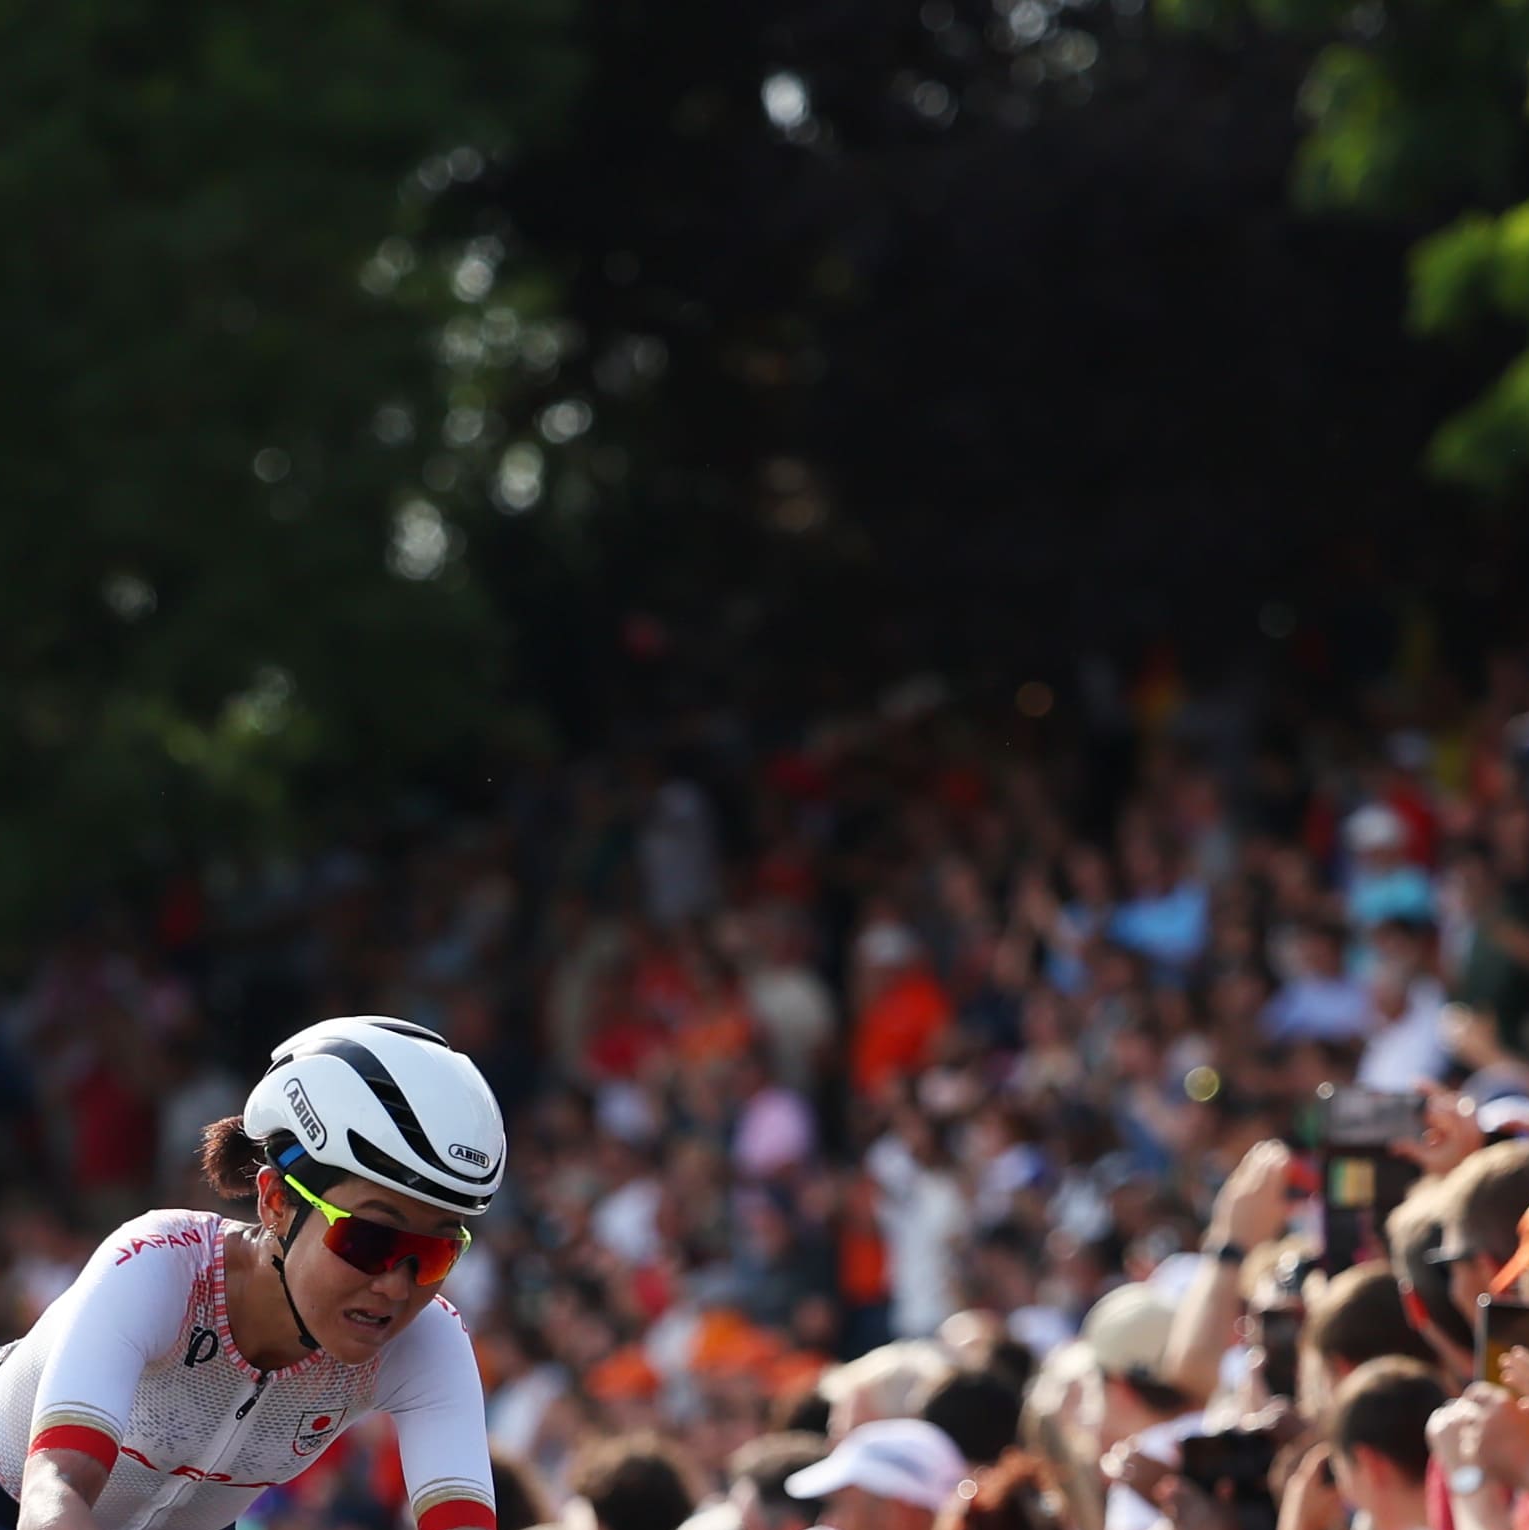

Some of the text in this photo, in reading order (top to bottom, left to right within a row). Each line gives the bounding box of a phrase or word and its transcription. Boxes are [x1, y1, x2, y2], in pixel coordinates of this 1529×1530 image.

[286, 1087, 321, 1142] ABUS
[454, 1147, 487, 1166] ABUS
[115, 1228, 202, 1266] JAPAN
